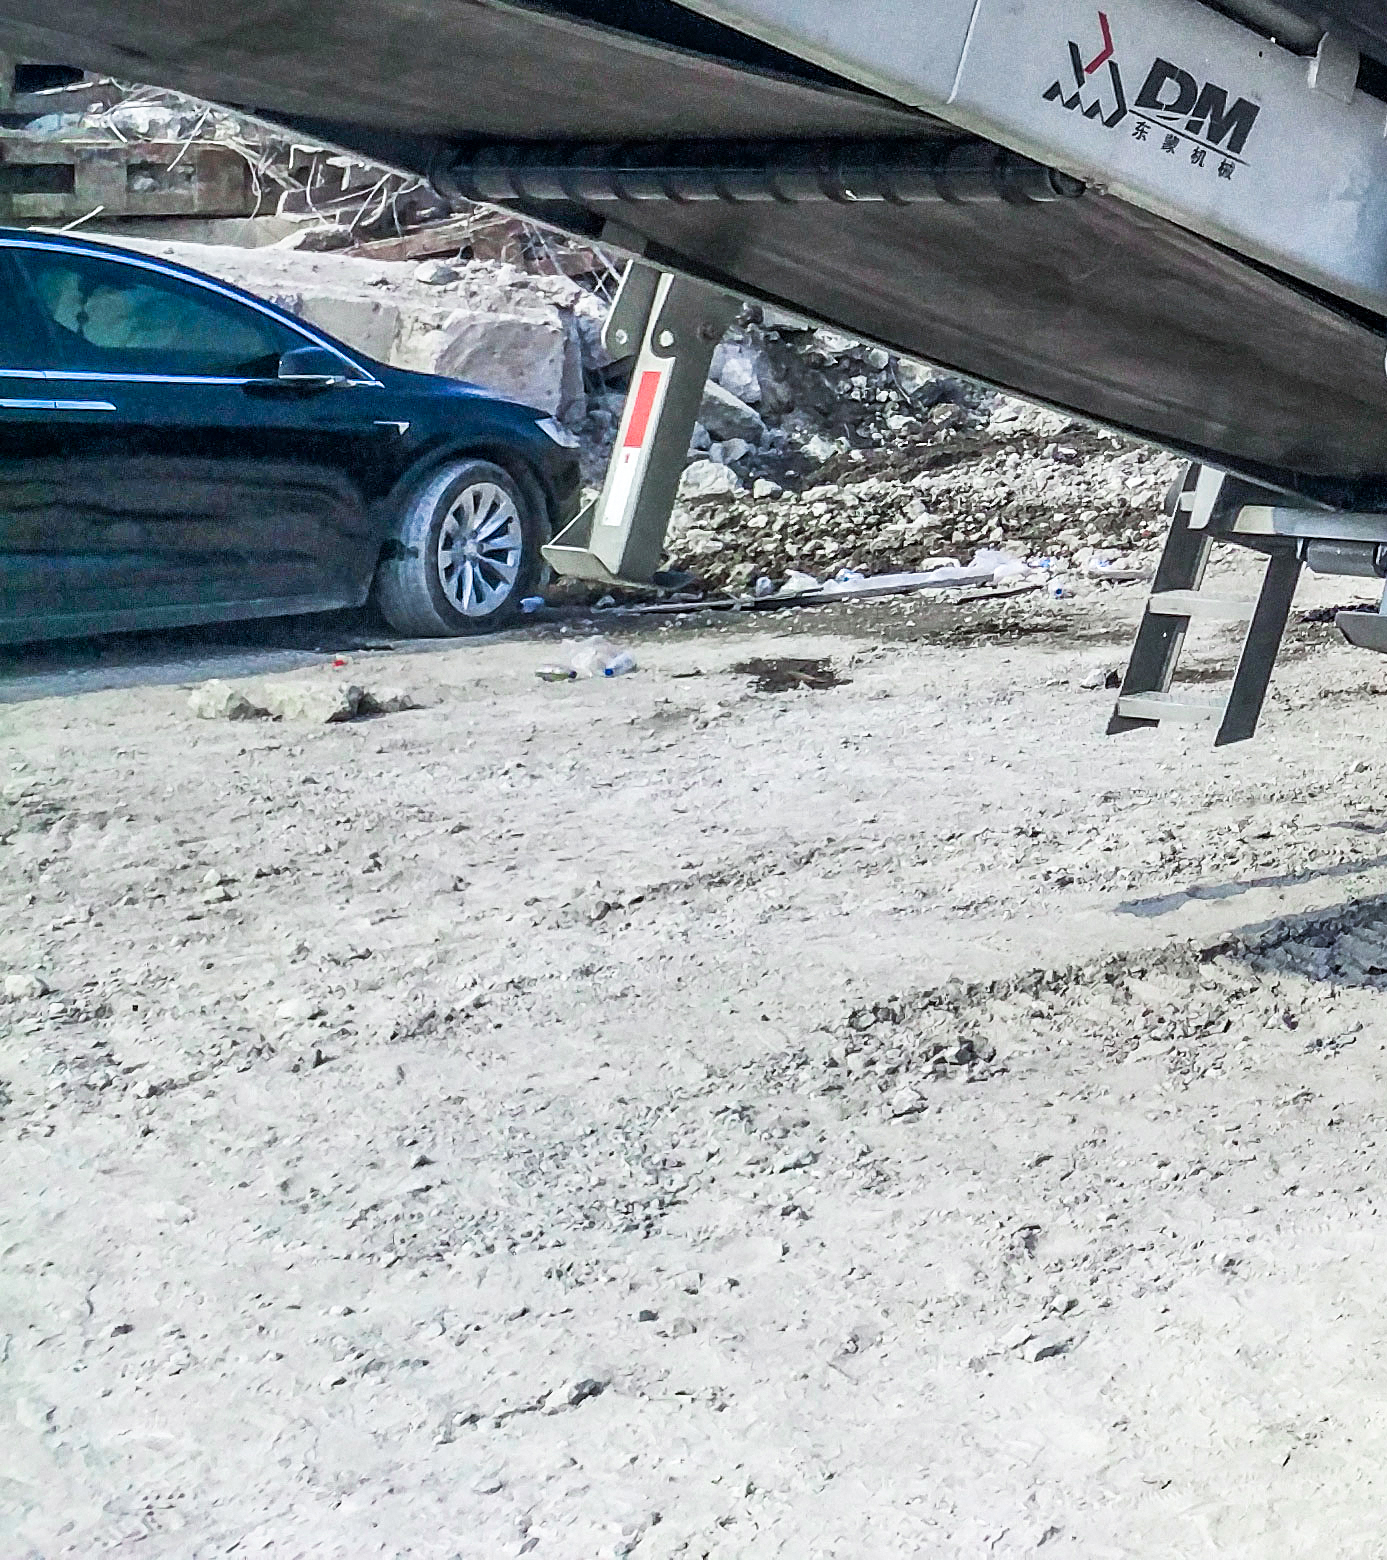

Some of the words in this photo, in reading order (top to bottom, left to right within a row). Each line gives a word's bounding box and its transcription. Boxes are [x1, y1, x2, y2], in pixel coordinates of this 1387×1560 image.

[1134, 57, 1260, 154] DM
[1131, 121, 1236, 180] 东蒙机械
